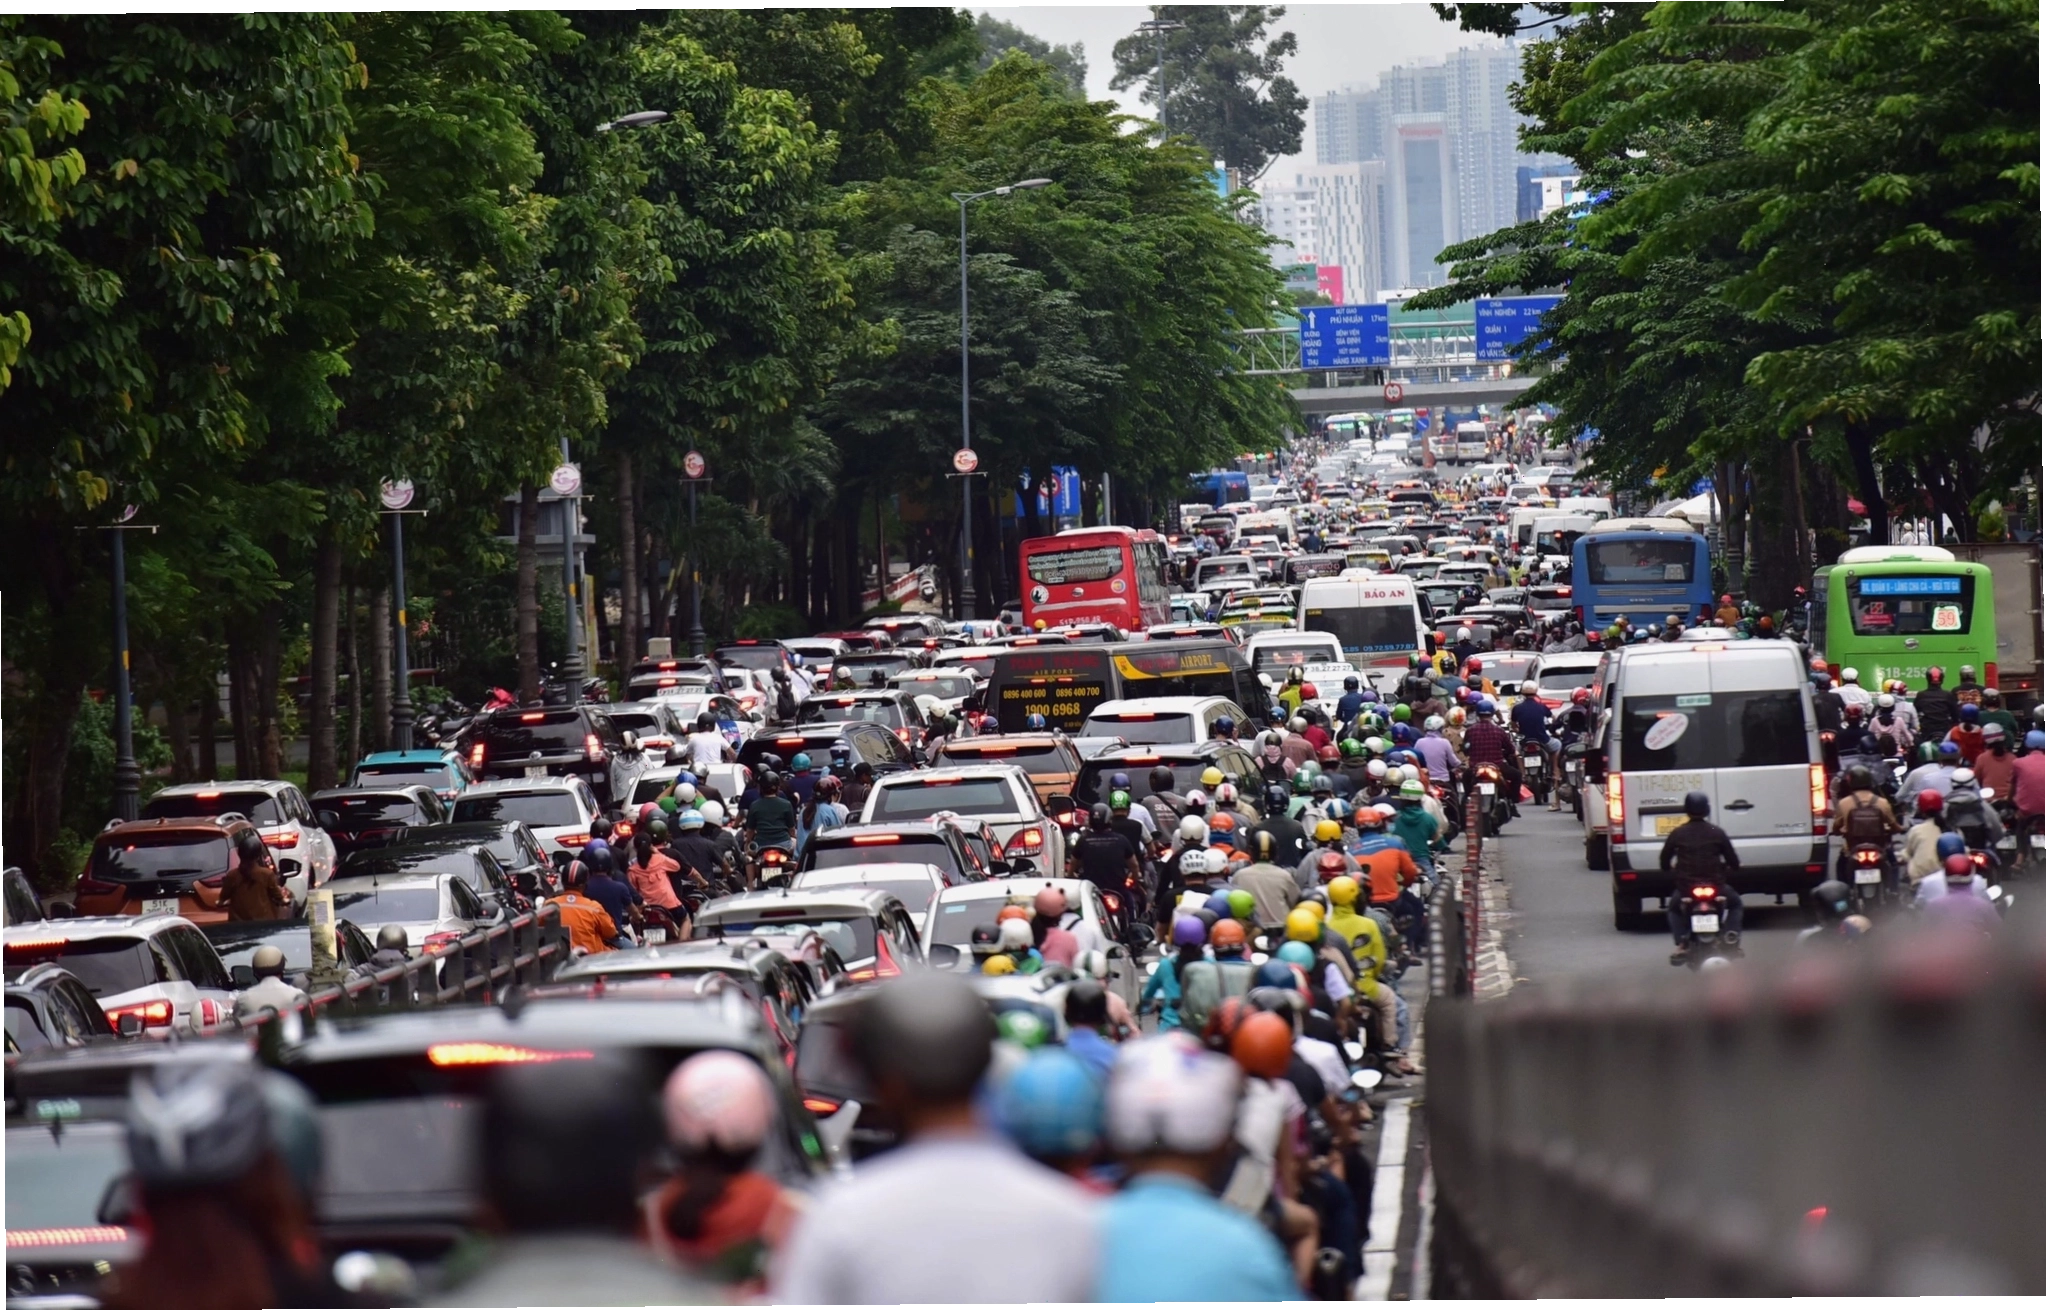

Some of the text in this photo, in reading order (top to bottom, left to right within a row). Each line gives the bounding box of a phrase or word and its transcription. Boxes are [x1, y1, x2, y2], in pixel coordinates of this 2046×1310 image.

[1389, 590, 1405, 598] AN
[1937, 612, 1955, 627] 59
[1180, 654, 1213, 668] AIRPORT
[1003, 688, 1047, 699] 0896 400 600
[1056, 686, 1100, 698] 0896 400 700
[1025, 702, 1080, 717] 1900 6968
